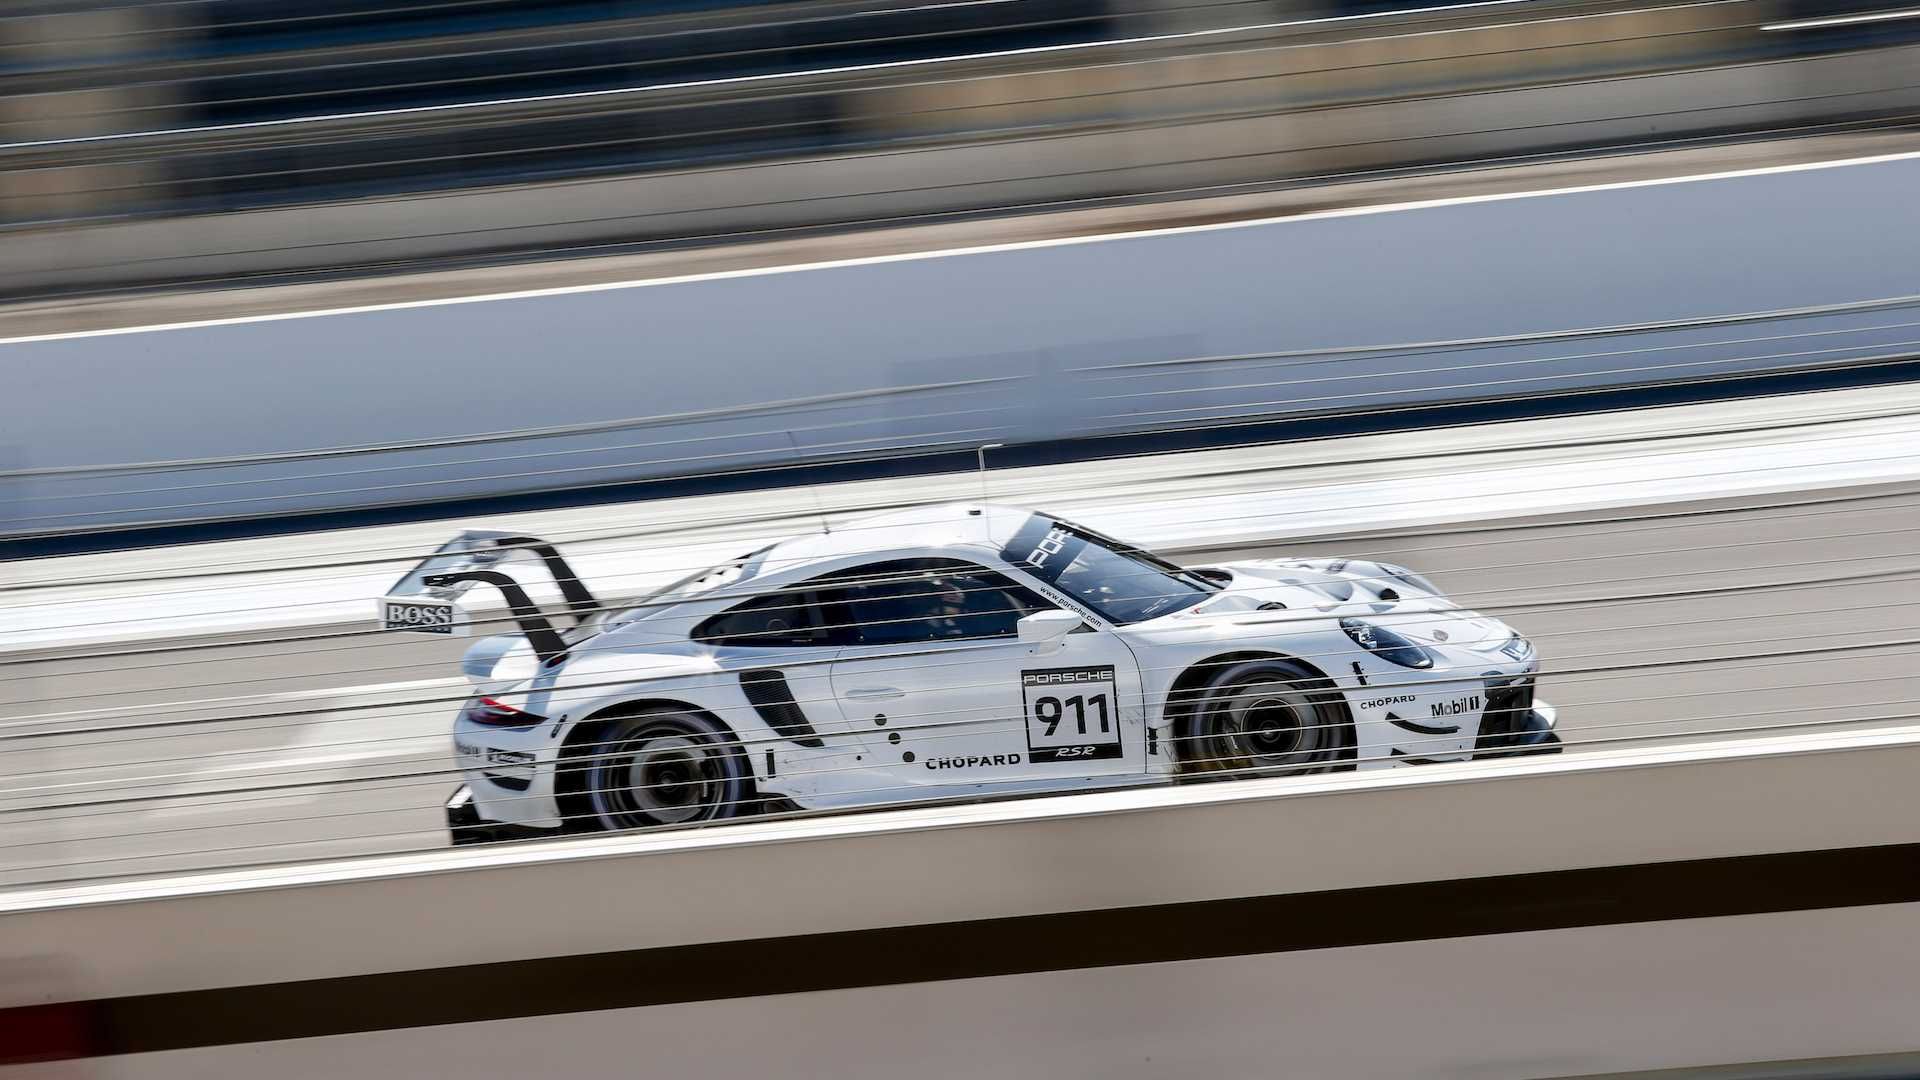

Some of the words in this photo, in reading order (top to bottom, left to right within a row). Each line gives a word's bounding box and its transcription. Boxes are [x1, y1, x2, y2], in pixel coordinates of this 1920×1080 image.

[388, 605, 451, 625] BOSS
[1040, 585, 1102, 627] www.porsche.com
[1024, 671, 1113, 684] PORSCHE
[1360, 695, 1416, 710] CHOPARD
[1431, 697, 1468, 716] Mobil
[1035, 693, 1110, 736] 911
[1055, 746, 1096, 757] RSR
[925, 753, 1021, 770] CHOPARD
